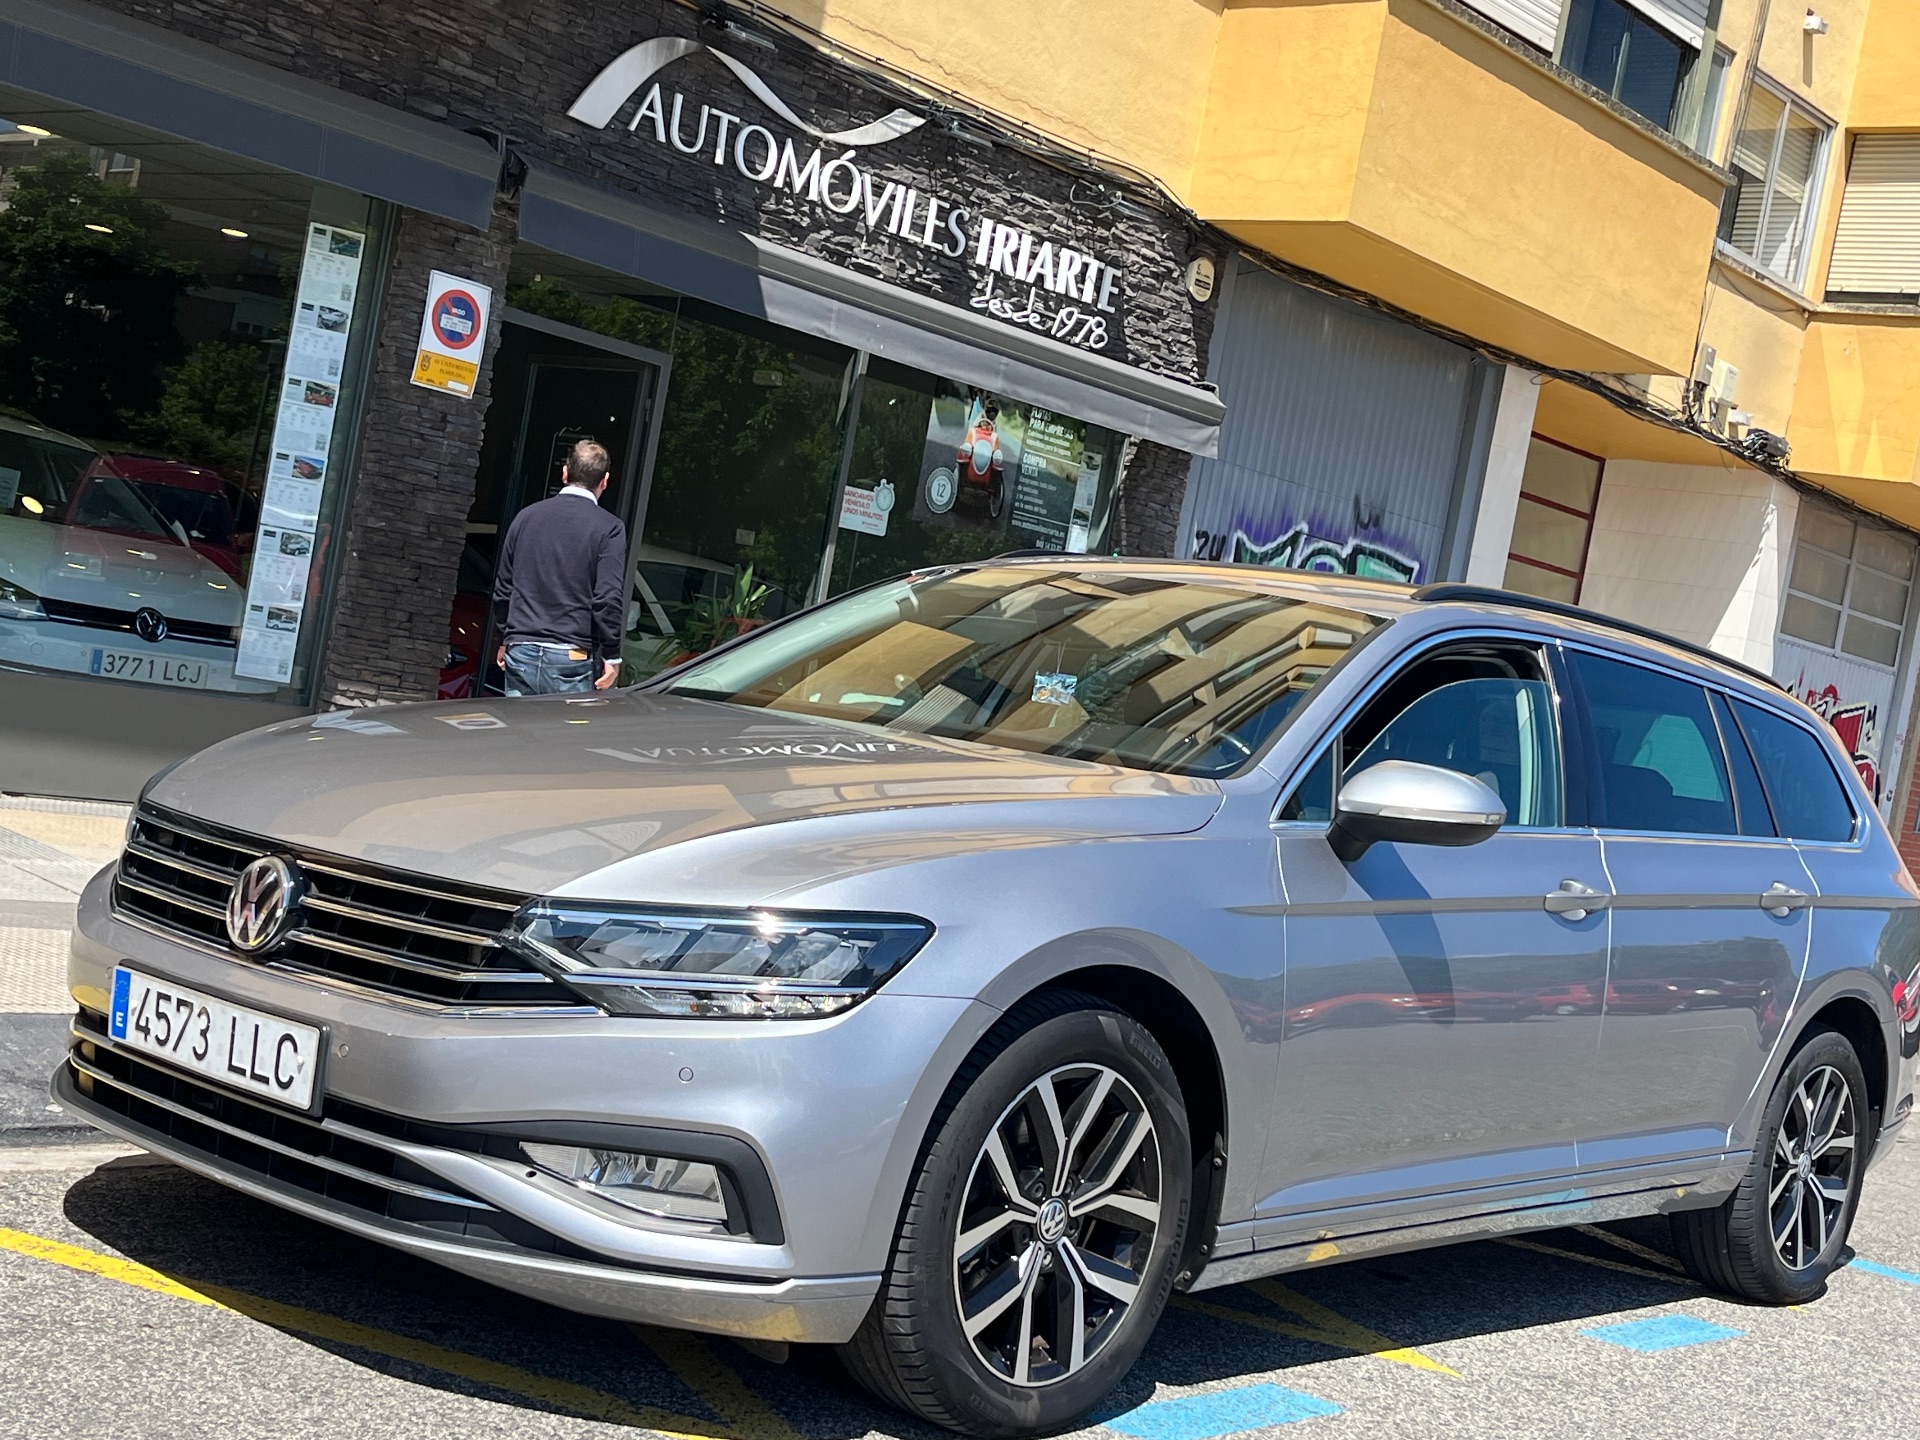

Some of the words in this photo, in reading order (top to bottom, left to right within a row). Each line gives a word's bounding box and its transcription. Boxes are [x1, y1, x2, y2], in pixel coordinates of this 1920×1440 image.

[627, 82, 970, 258] AUTOMÓVILES
[976, 217, 1122, 314] IRIARTE
[970, 272, 1048, 330] desde
[1051, 307, 1109, 349] 1978
[1023, 452, 1047, 469] COMPRA
[937, 482, 946, 498] 12
[103, 654, 155, 678] 3771
[163, 661, 202, 684] LCJ
[114, 1011, 124, 1028] E
[134, 987, 211, 1062] 4573
[227, 1015, 299, 1090] LLC
